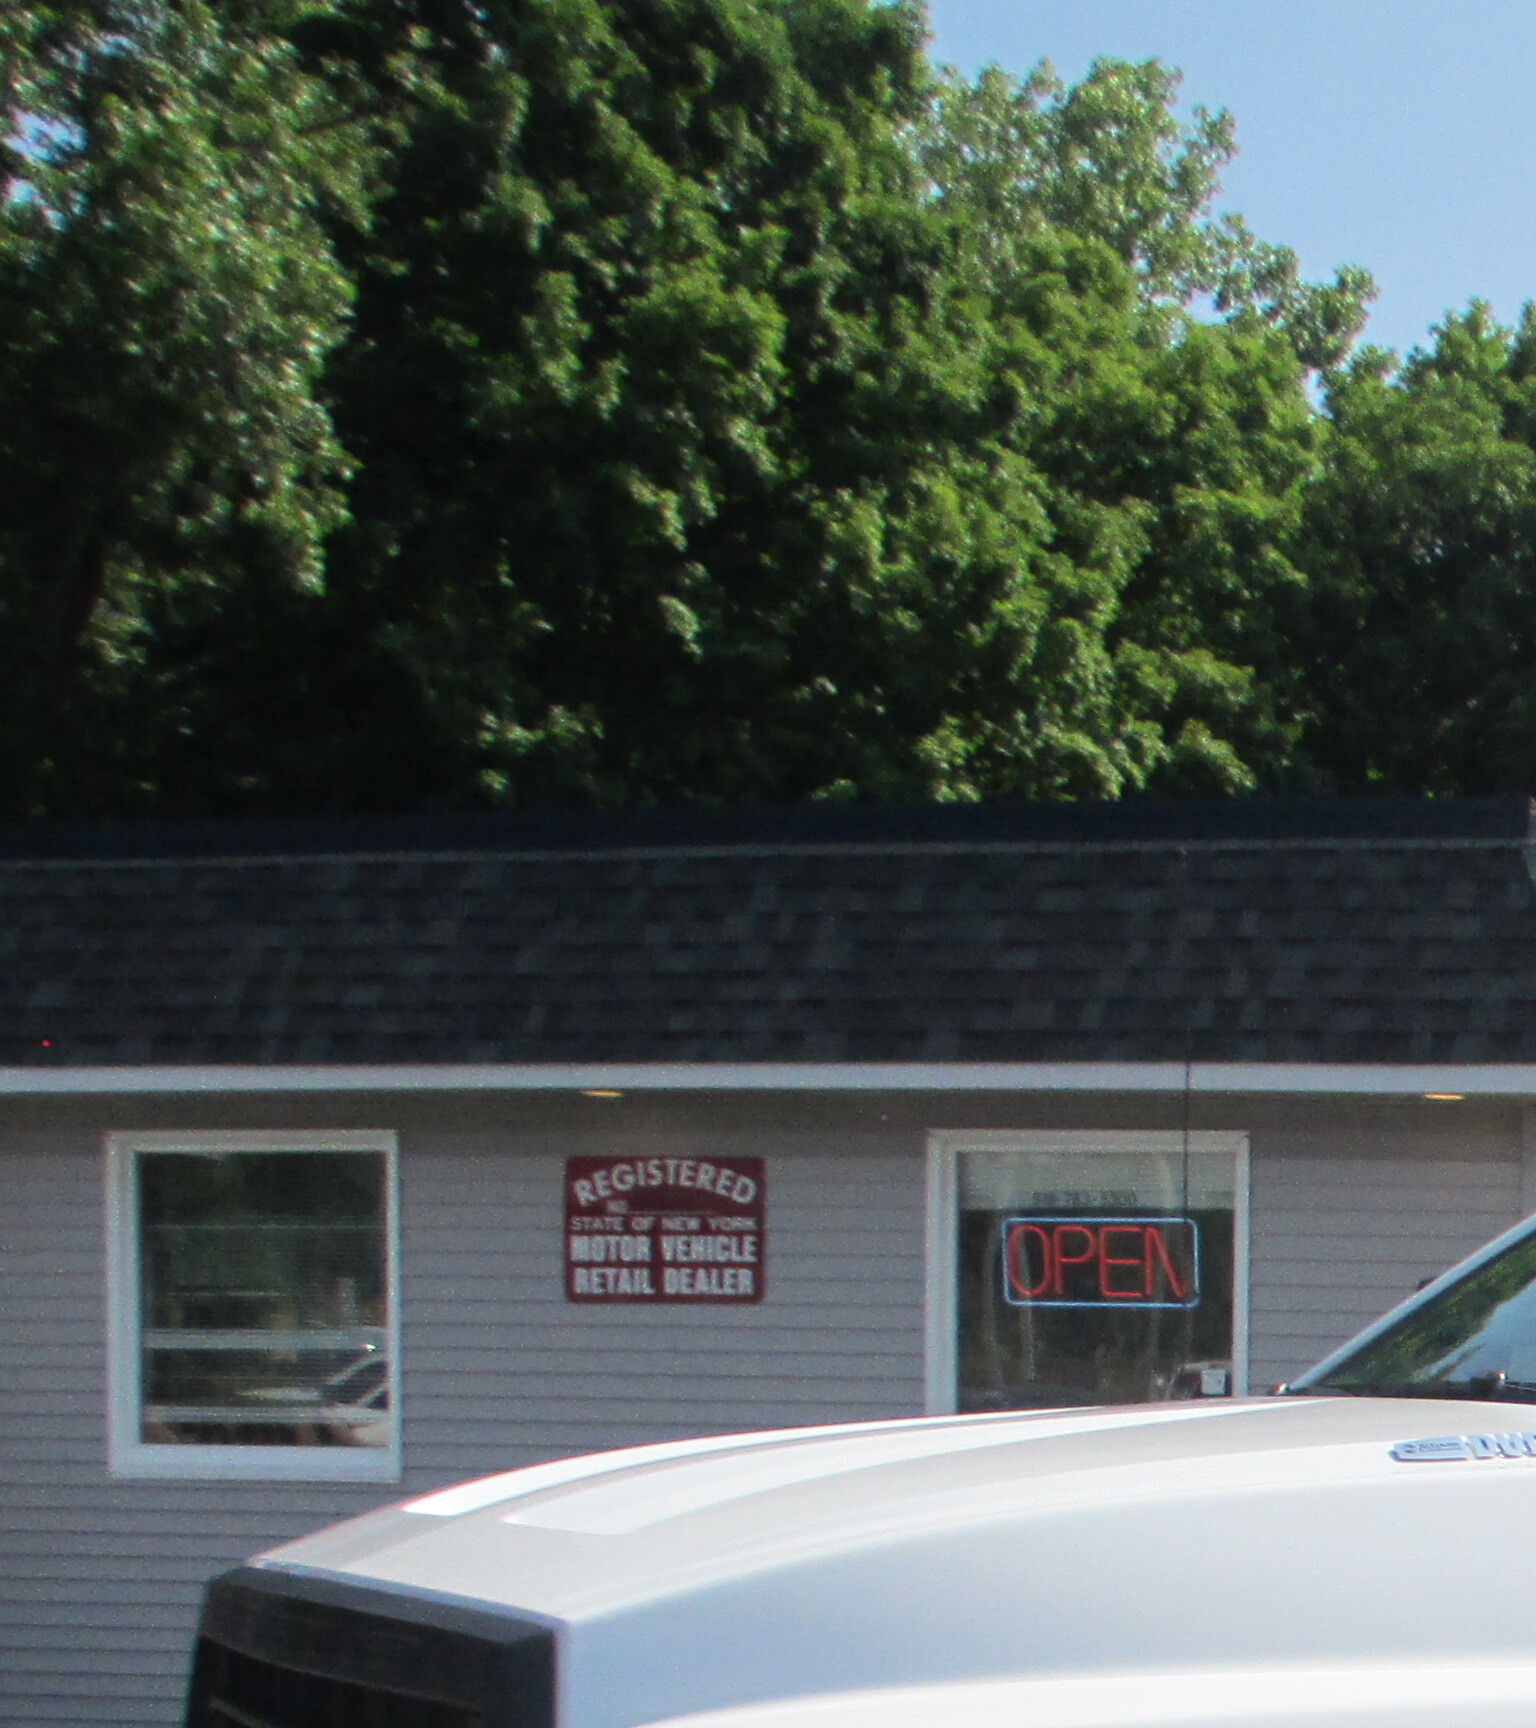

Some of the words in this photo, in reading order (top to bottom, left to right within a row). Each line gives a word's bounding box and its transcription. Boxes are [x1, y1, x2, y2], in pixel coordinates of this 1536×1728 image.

[573, 1159, 757, 1207] REGISTERED
[571, 1216, 625, 1231] STATE
[631, 1216, 655, 1231] OF
[661, 1217, 700, 1231] NEW
[705, 1217, 757, 1231] YORK
[570, 1235, 651, 1262] MOTOR
[660, 1235, 758, 1262] VEHICLE
[1008, 1224, 1188, 1298] OPEN
[573, 1267, 655, 1294] RETAIL
[663, 1267, 755, 1294] DEALER
